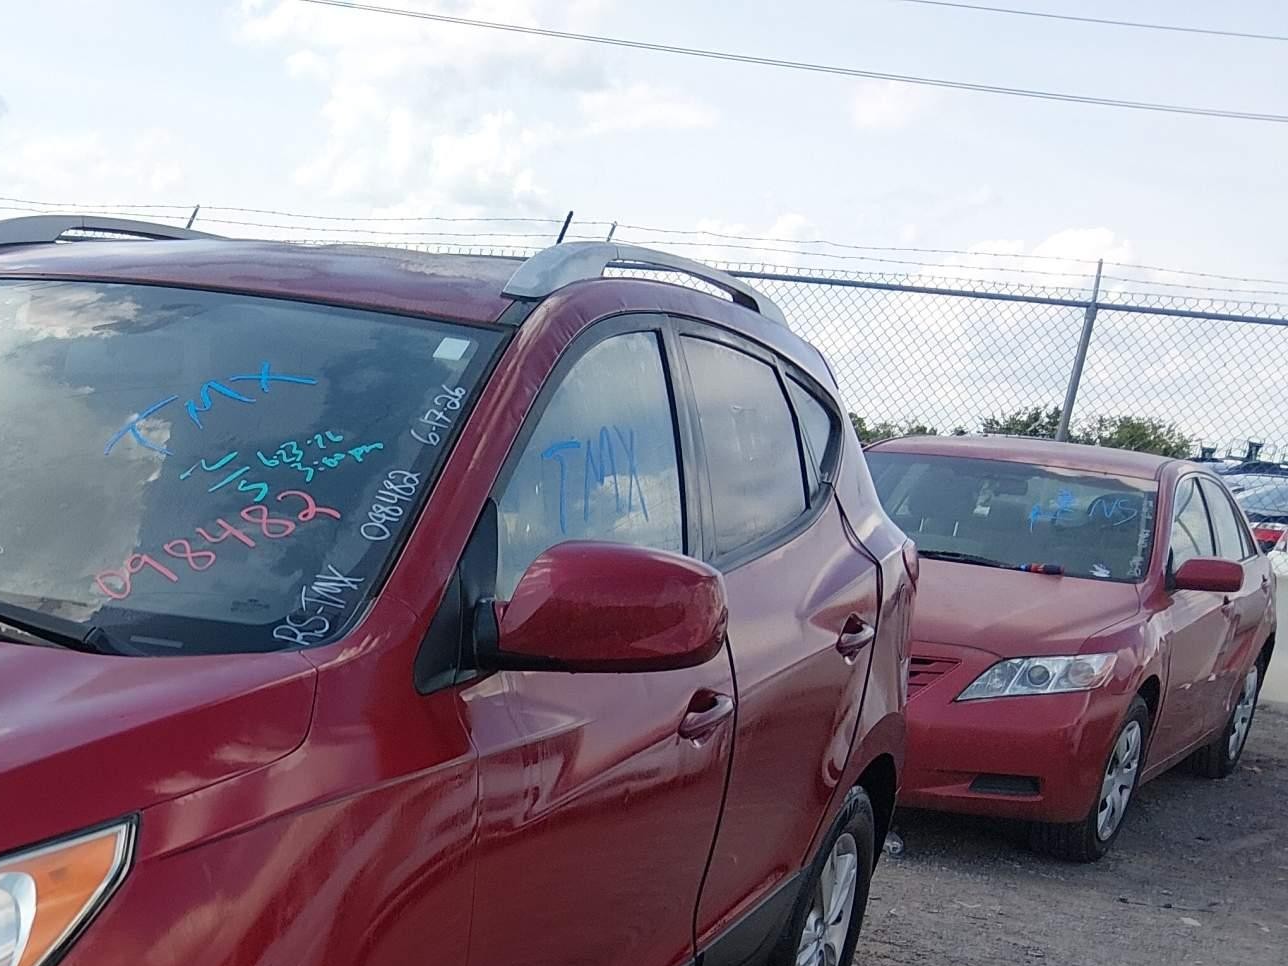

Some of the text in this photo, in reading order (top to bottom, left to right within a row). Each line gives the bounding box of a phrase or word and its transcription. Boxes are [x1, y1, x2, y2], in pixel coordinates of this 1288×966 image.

[104, 361, 318, 456] TMX
[360, 469, 421, 542] 098482
[540, 424, 649, 536] TMX
[94, 490, 342, 601] 098482
[272, 564, 365, 646] RS-TMX
